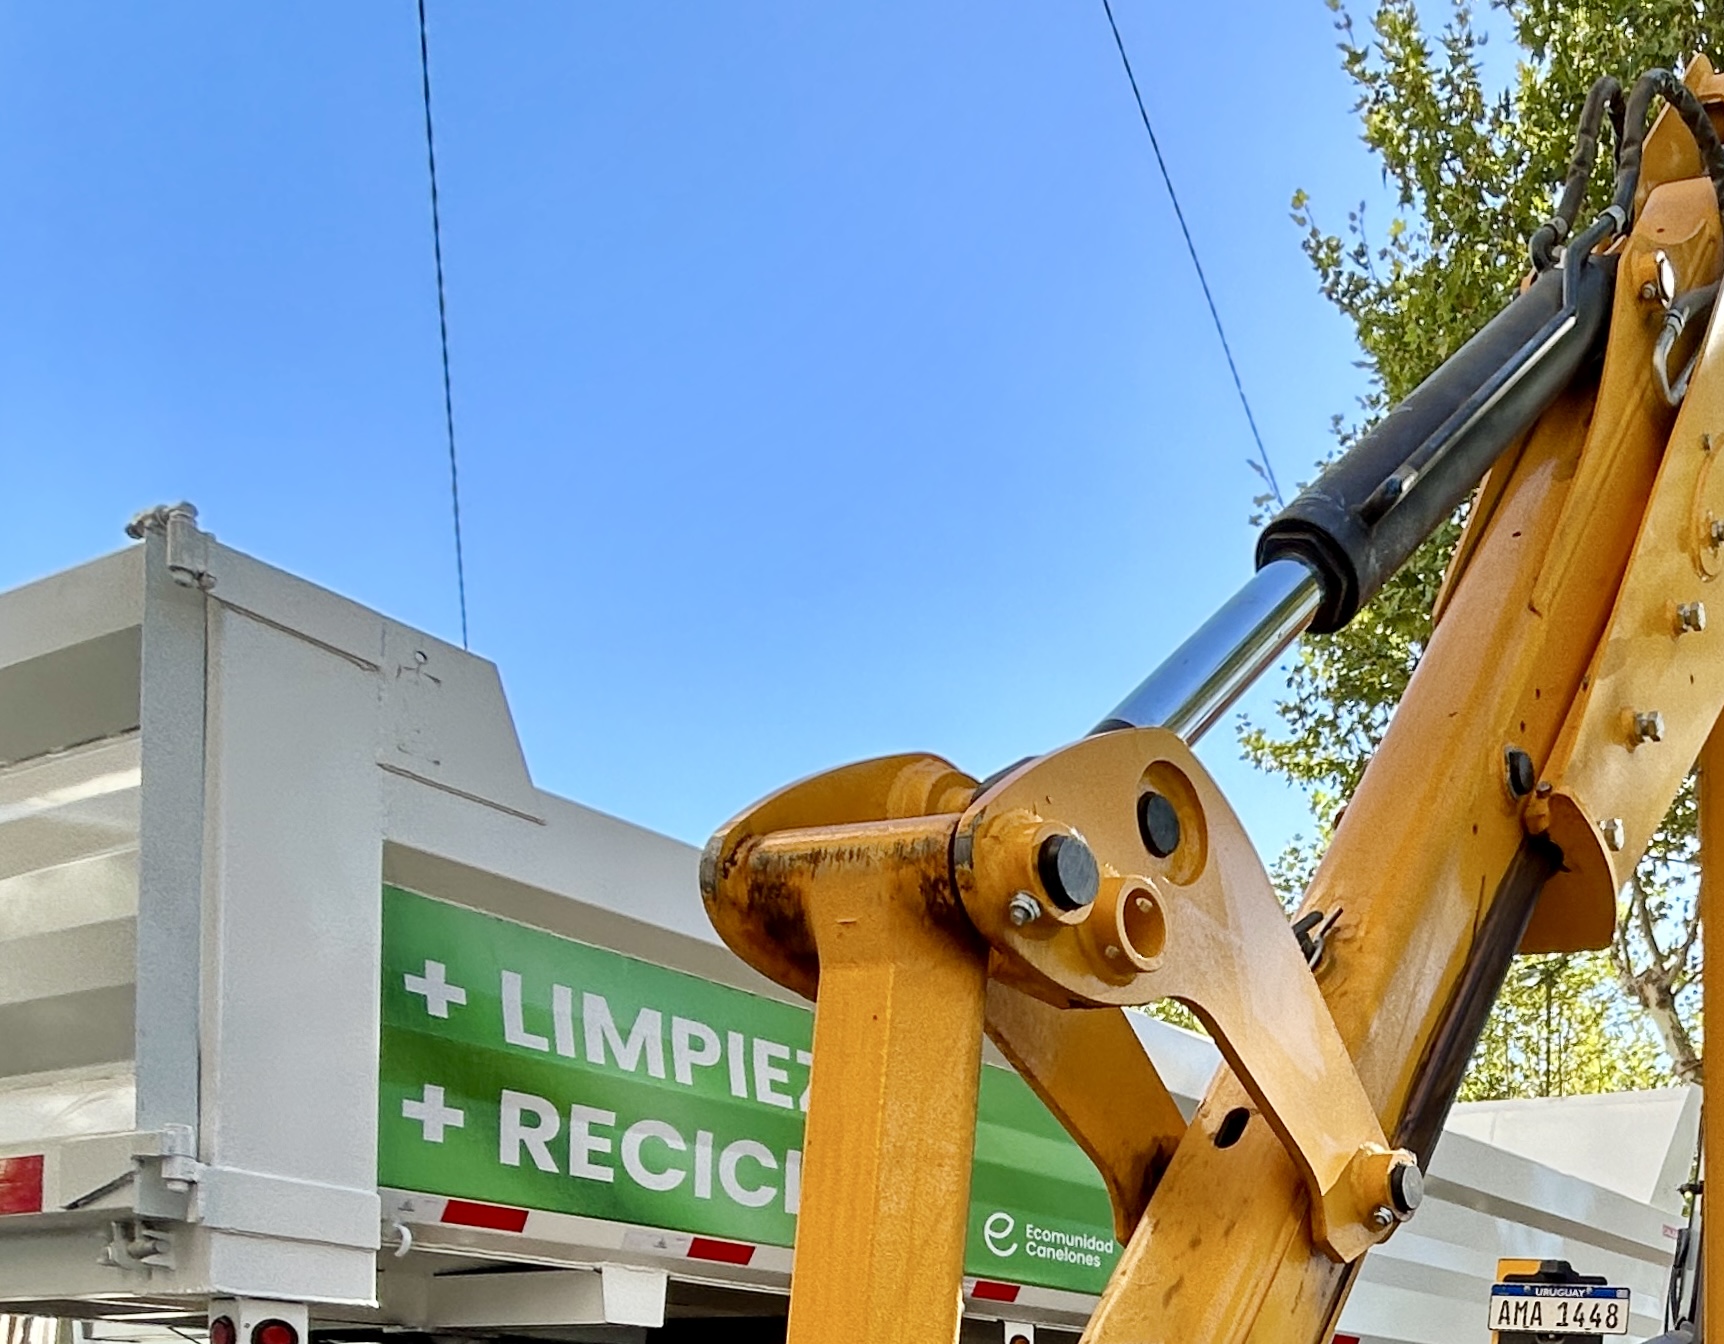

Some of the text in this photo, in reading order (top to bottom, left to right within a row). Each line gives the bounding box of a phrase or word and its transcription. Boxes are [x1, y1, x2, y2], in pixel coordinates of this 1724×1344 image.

[1026, 1223, 1114, 1254] Ecomunidad
[1026, 1241, 1101, 1267] Canelones
[1535, 1287, 1586, 1298] URUGUAY
[1498, 1299, 1619, 1329] AMA 1448
